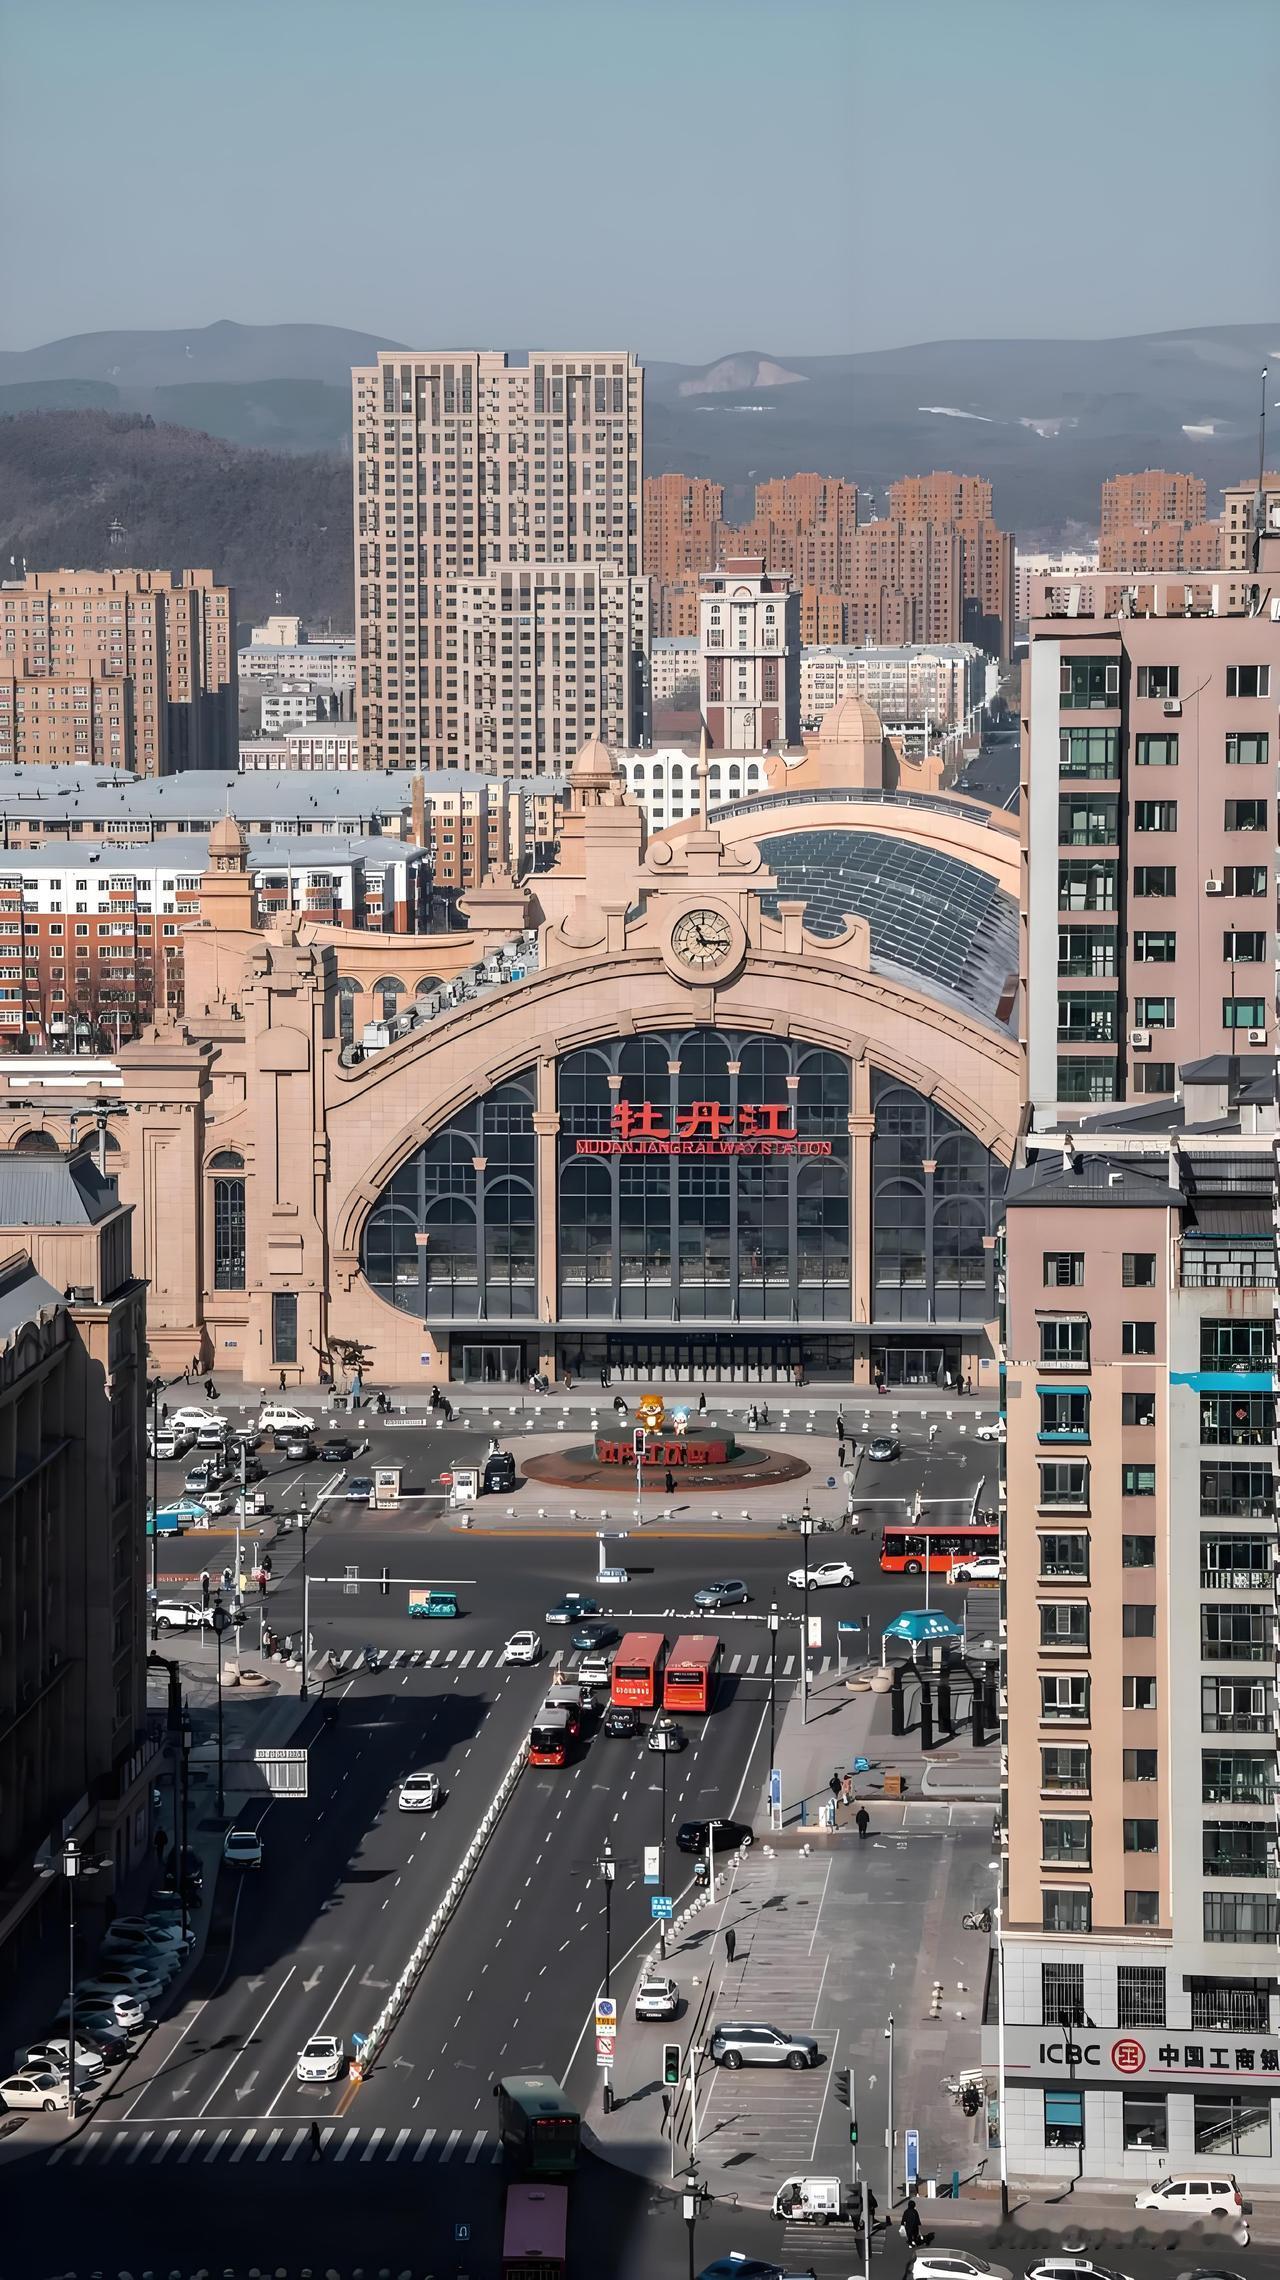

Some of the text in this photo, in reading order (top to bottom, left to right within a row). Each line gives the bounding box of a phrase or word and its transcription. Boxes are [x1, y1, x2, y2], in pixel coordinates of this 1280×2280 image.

[610, 1100, 798, 1139] 牡丹江
[576, 1140, 680, 1154] MUDANJIANG
[1039, 2043, 1101, 2066] ICBC
